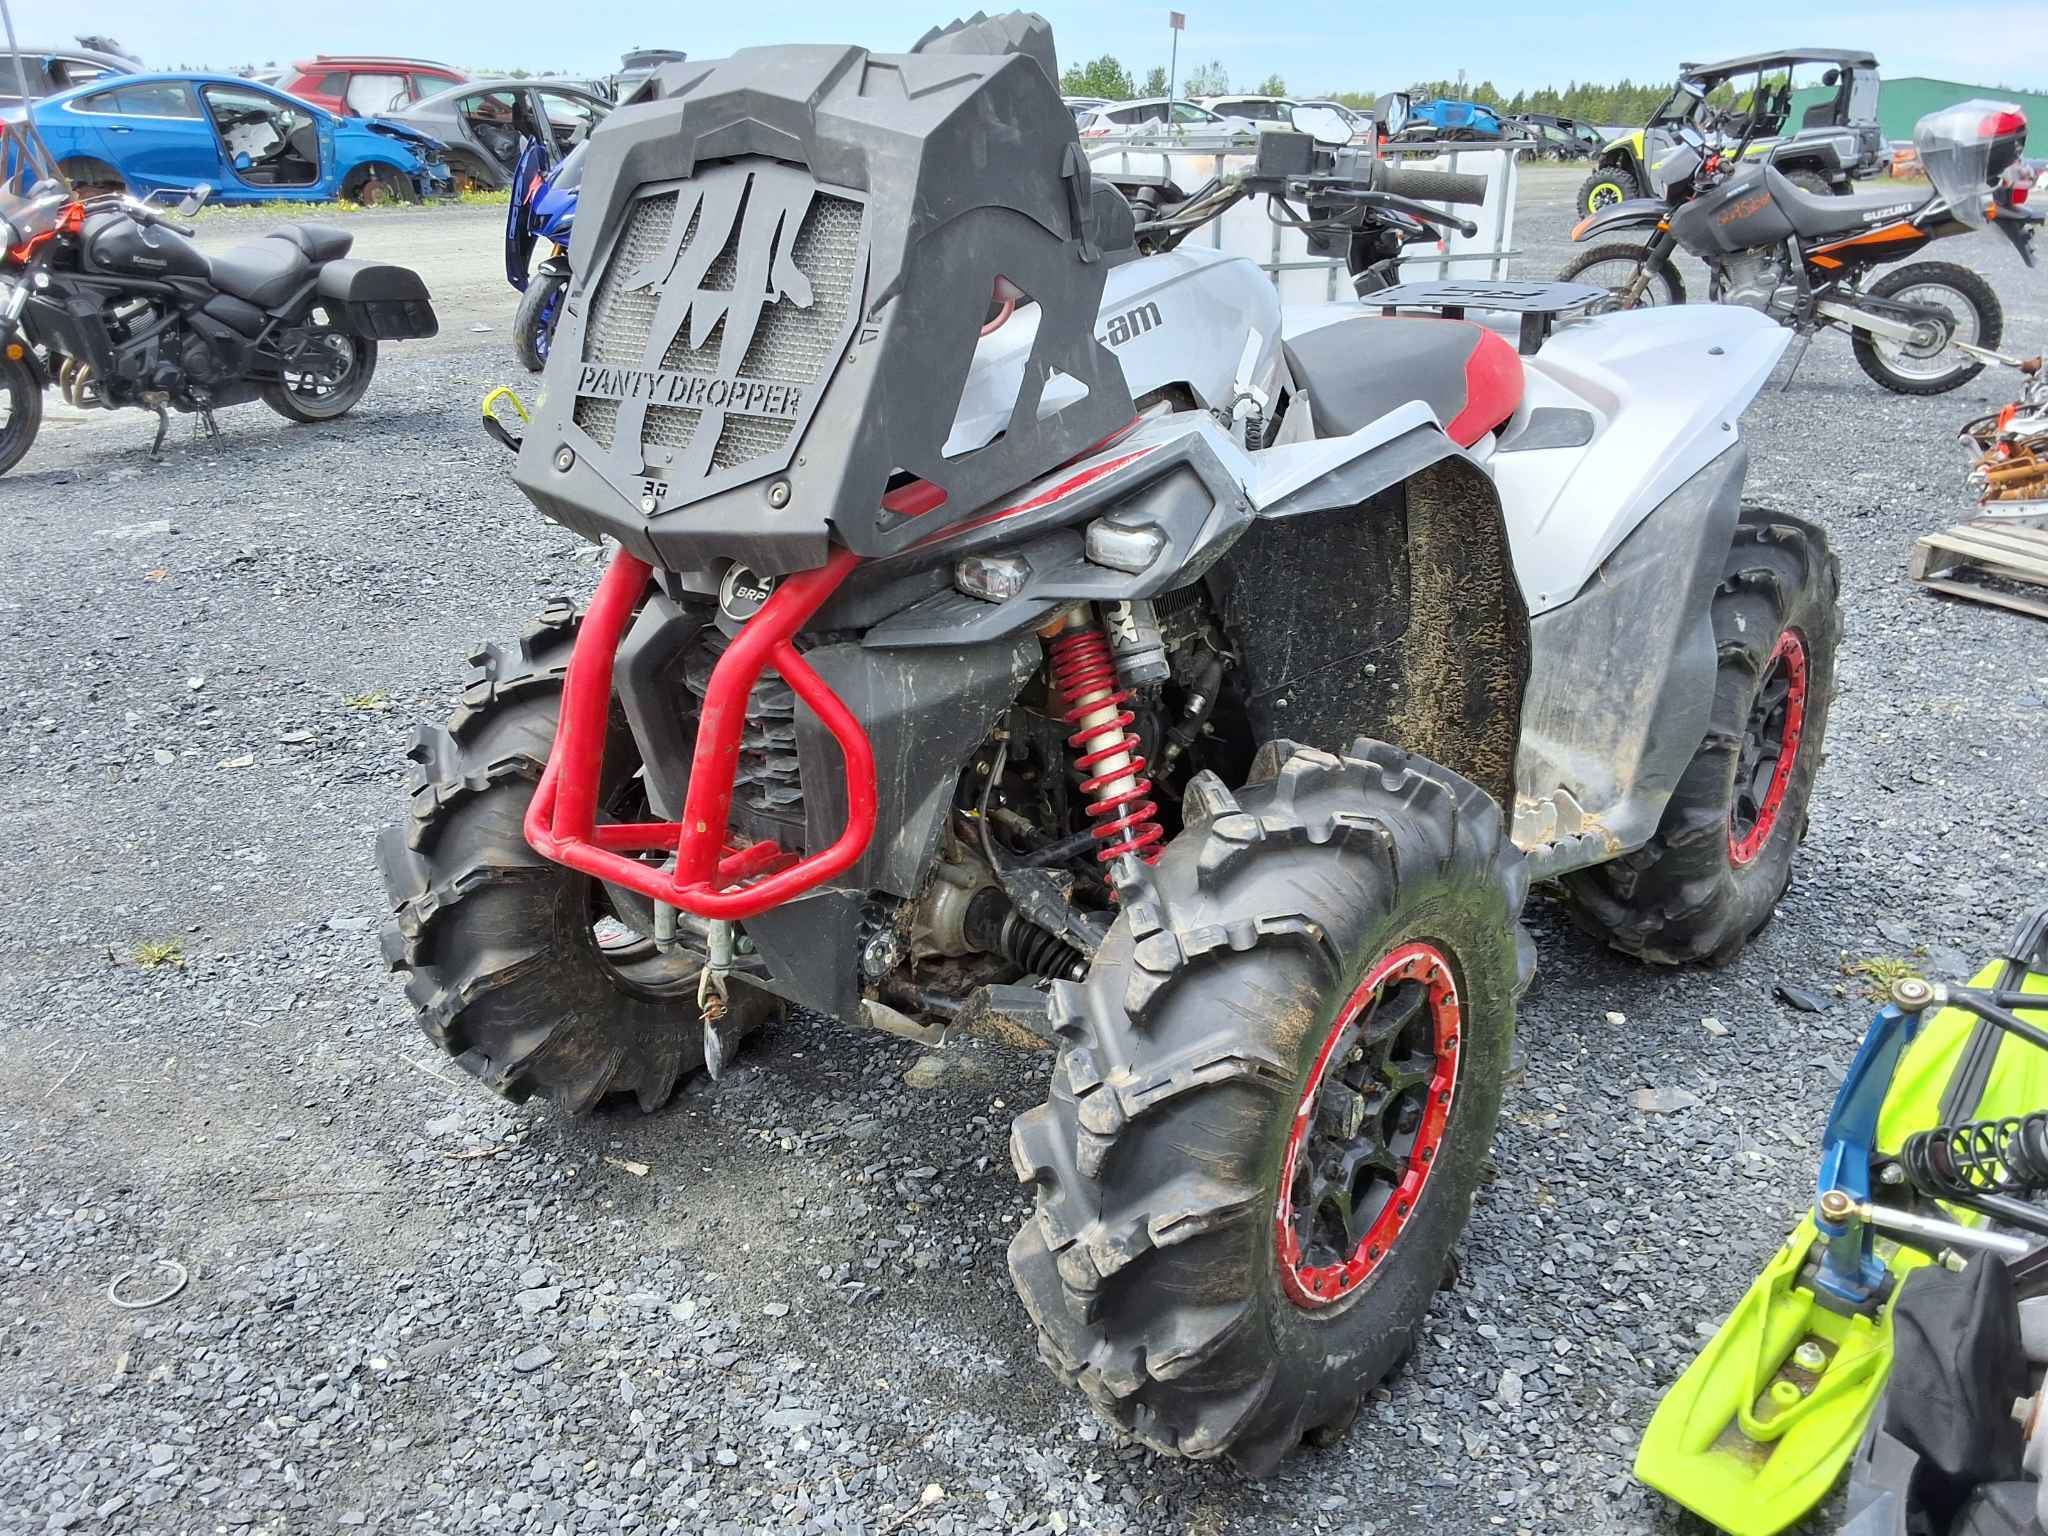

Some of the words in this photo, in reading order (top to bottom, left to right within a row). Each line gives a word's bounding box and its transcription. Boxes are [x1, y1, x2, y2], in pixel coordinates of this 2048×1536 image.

[1863, 203, 1912, 221] SUZUKI
[1098, 302, 1162, 347] -am
[577, 367, 665, 399] PANTY
[668, 376, 802, 416] DROPPER
[736, 586, 767, 601] BRP
